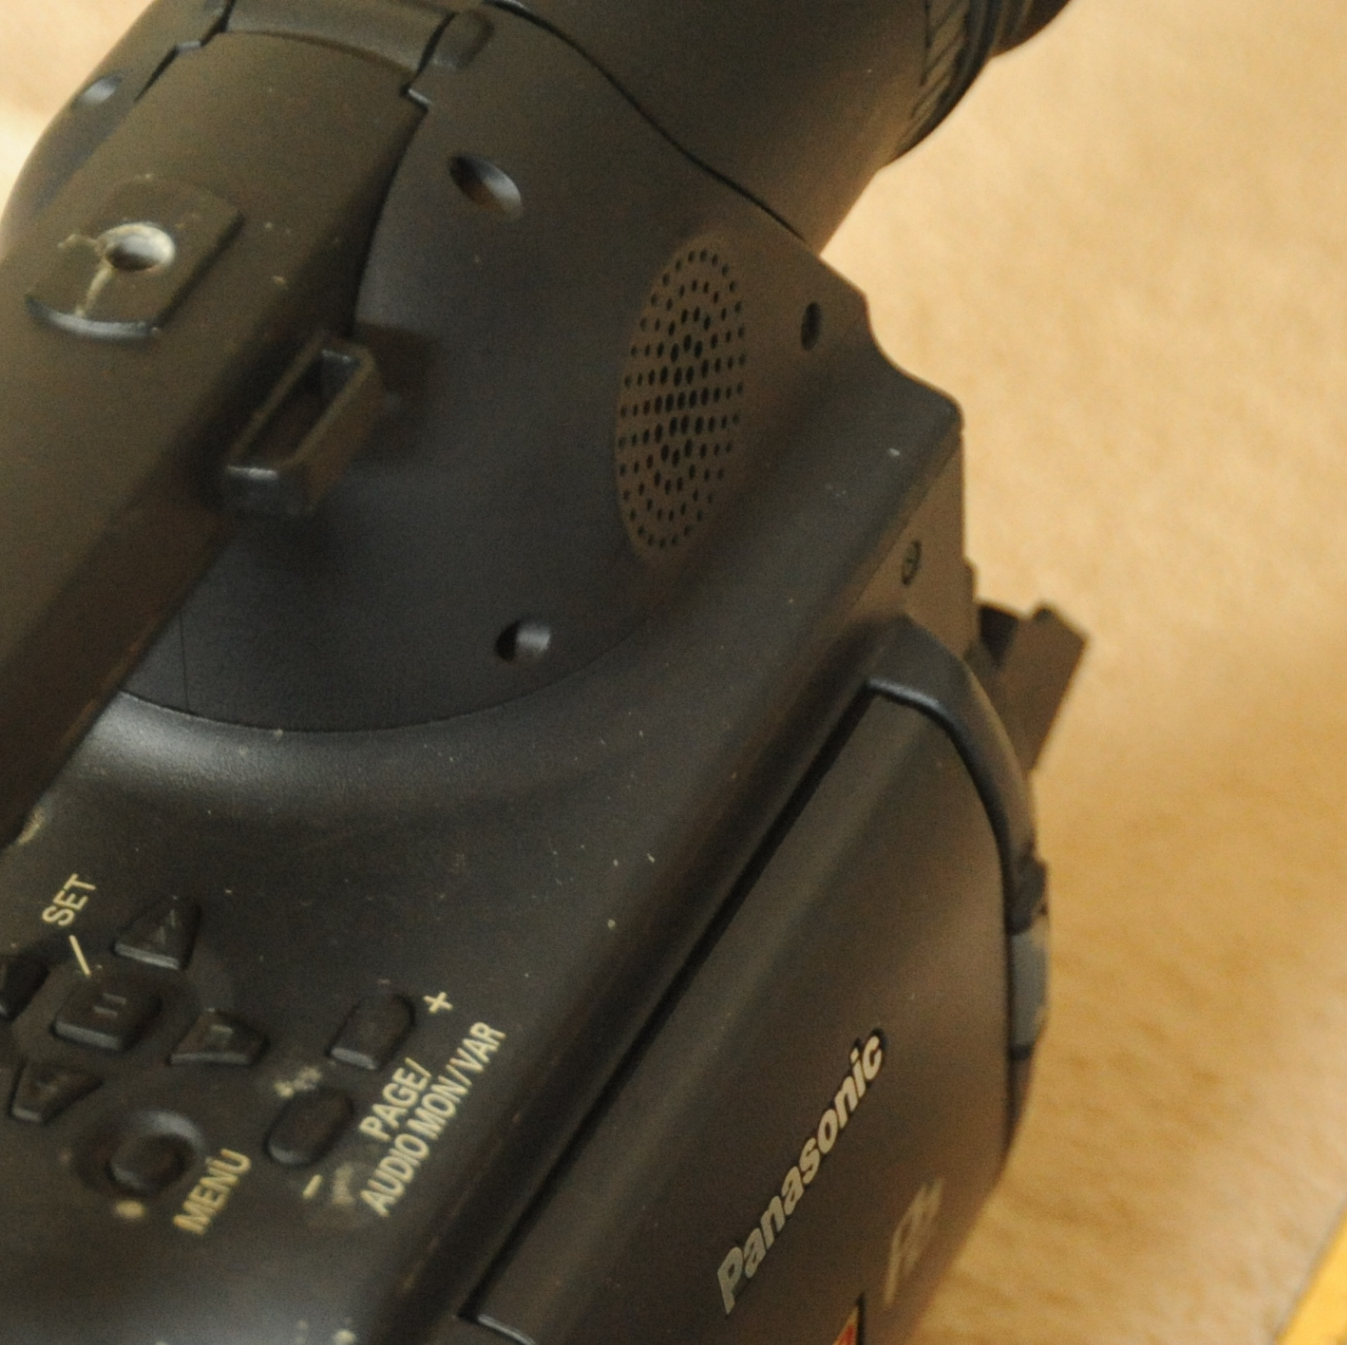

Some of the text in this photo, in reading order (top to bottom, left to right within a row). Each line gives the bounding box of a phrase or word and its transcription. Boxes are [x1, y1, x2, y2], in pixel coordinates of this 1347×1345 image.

[42, 873, 96, 926] SET
[359, 1057, 432, 1142] PAGE/
[360, 1021, 506, 1218] AUDIO MON/VAR
[172, 1149, 251, 1235] MENU
[716, 1033, 885, 1315] Panasonic
